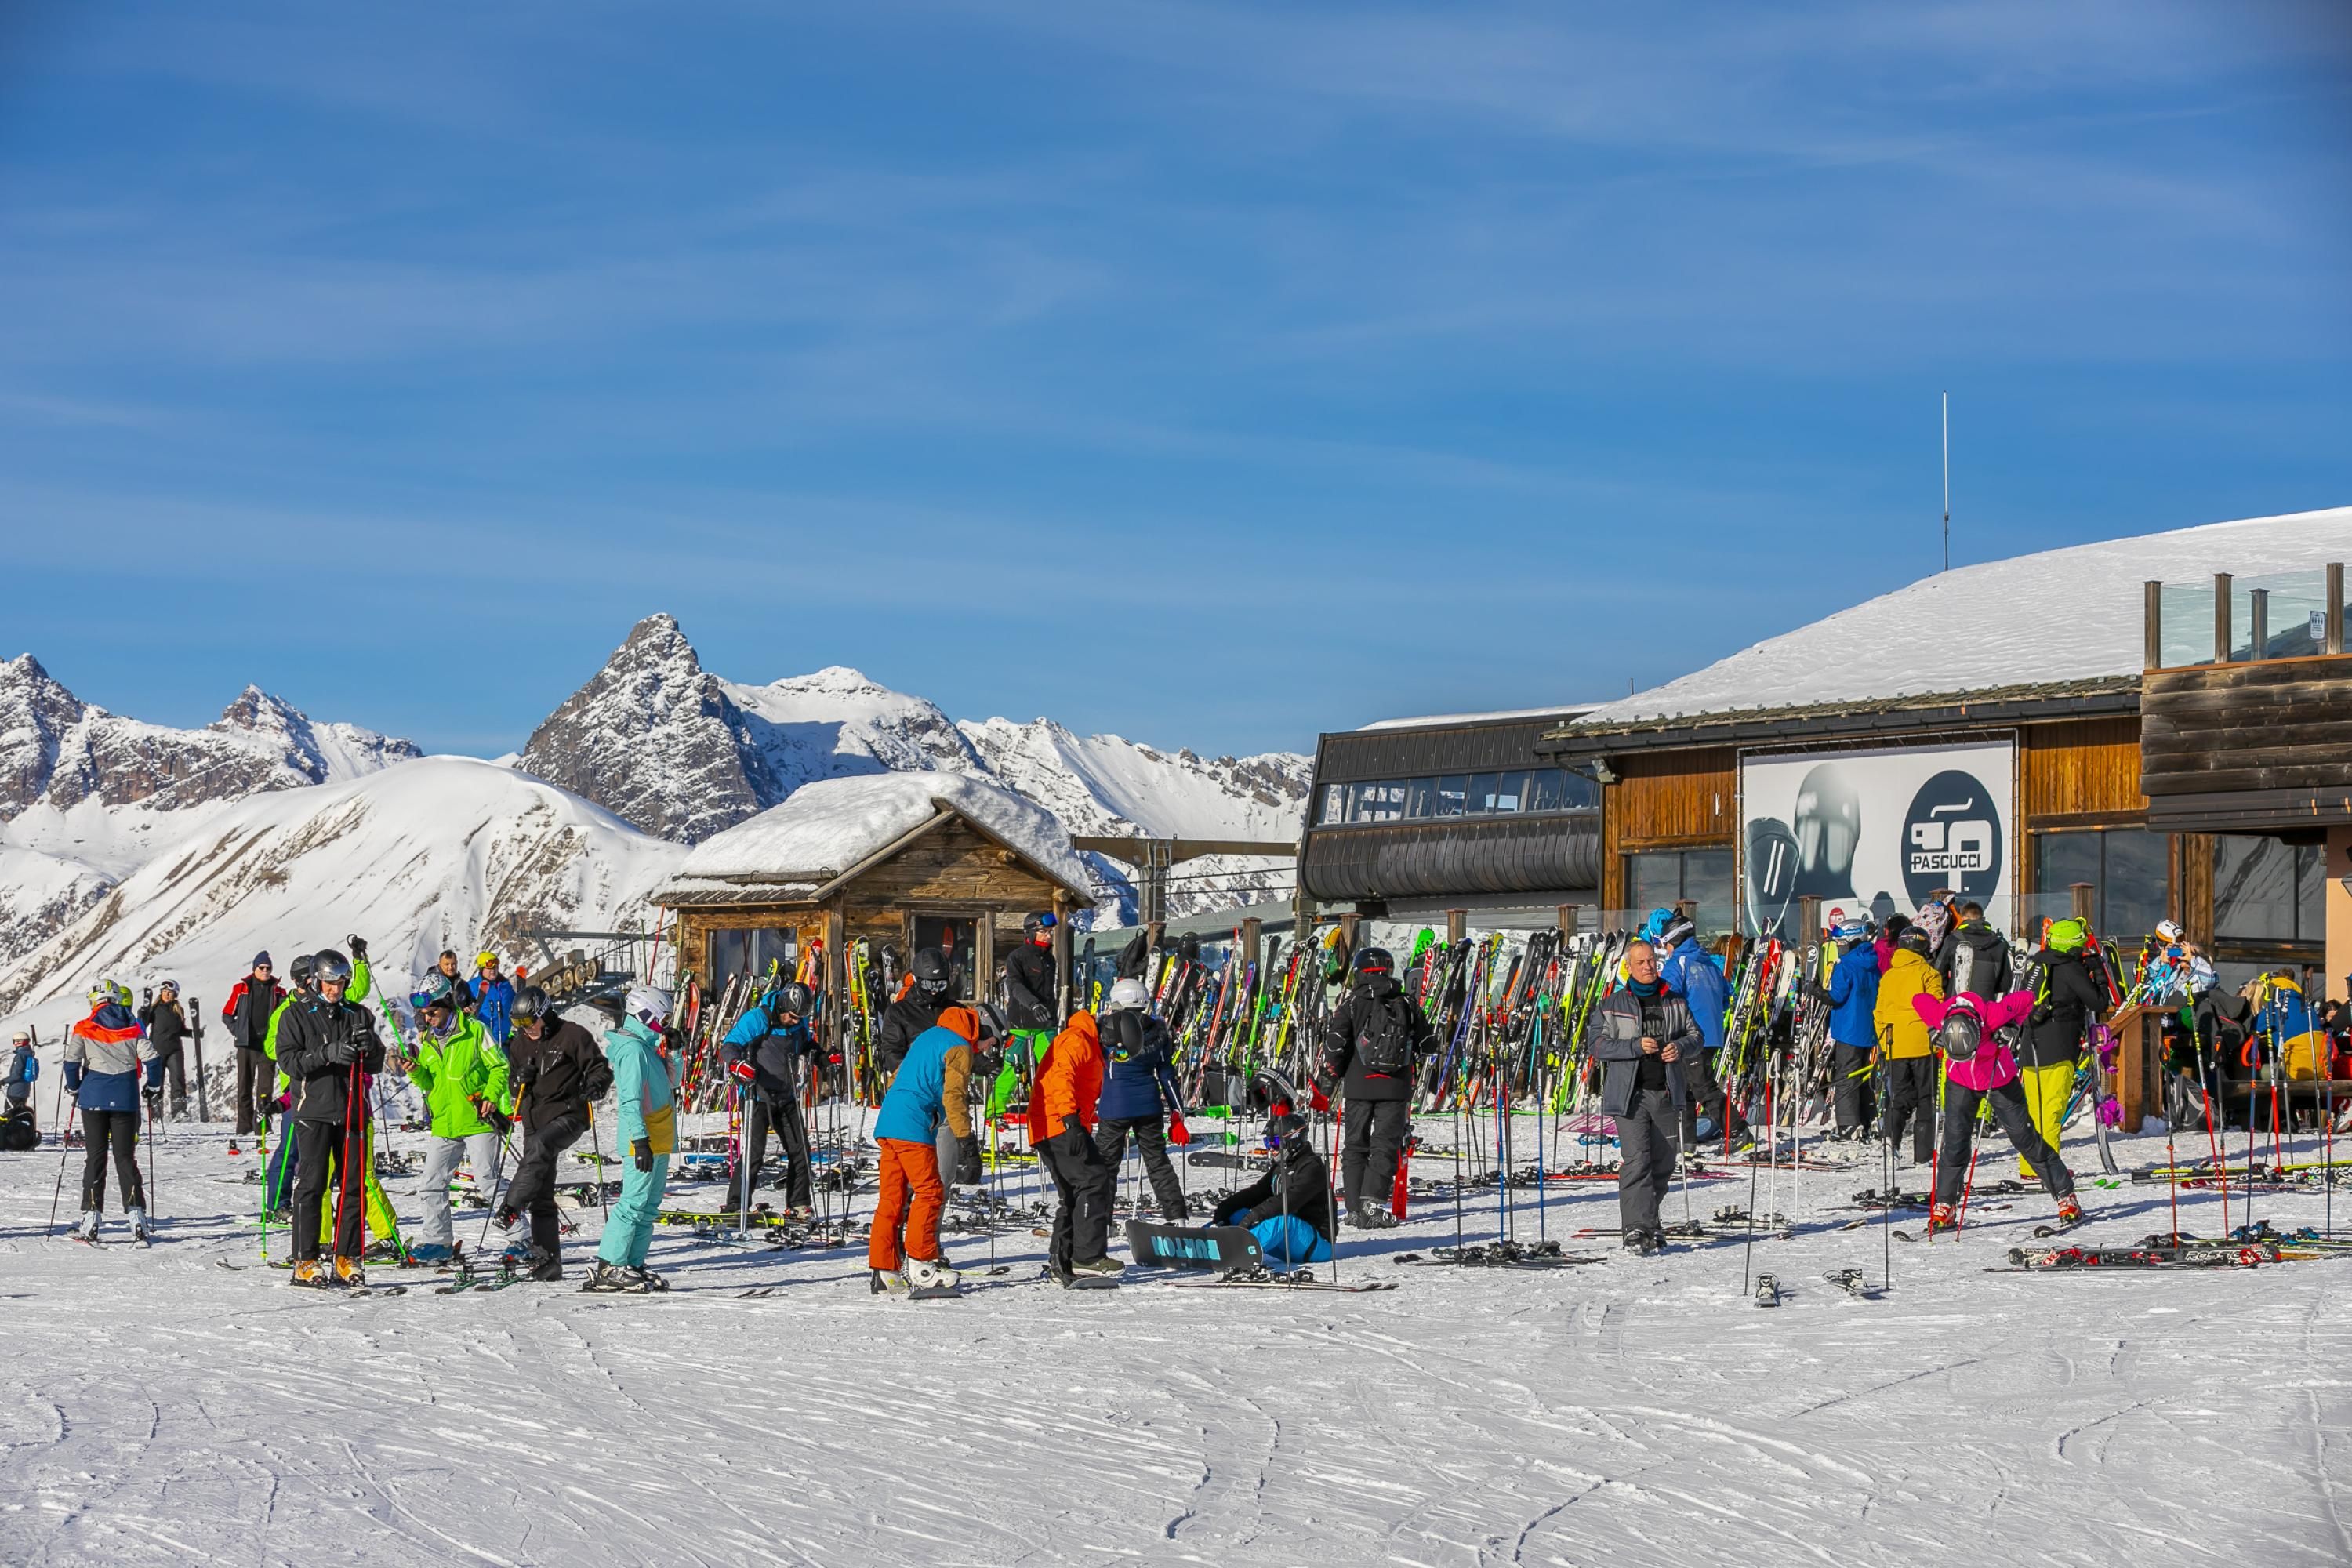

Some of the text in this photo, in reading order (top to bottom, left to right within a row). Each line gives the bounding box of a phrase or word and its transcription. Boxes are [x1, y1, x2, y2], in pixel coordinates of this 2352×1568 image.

[1913, 854, 1980, 869] PASCUCCI
[1151, 1235, 1221, 1261] BURTON
[2184, 1250, 2272, 1261] ROSSIGOL
